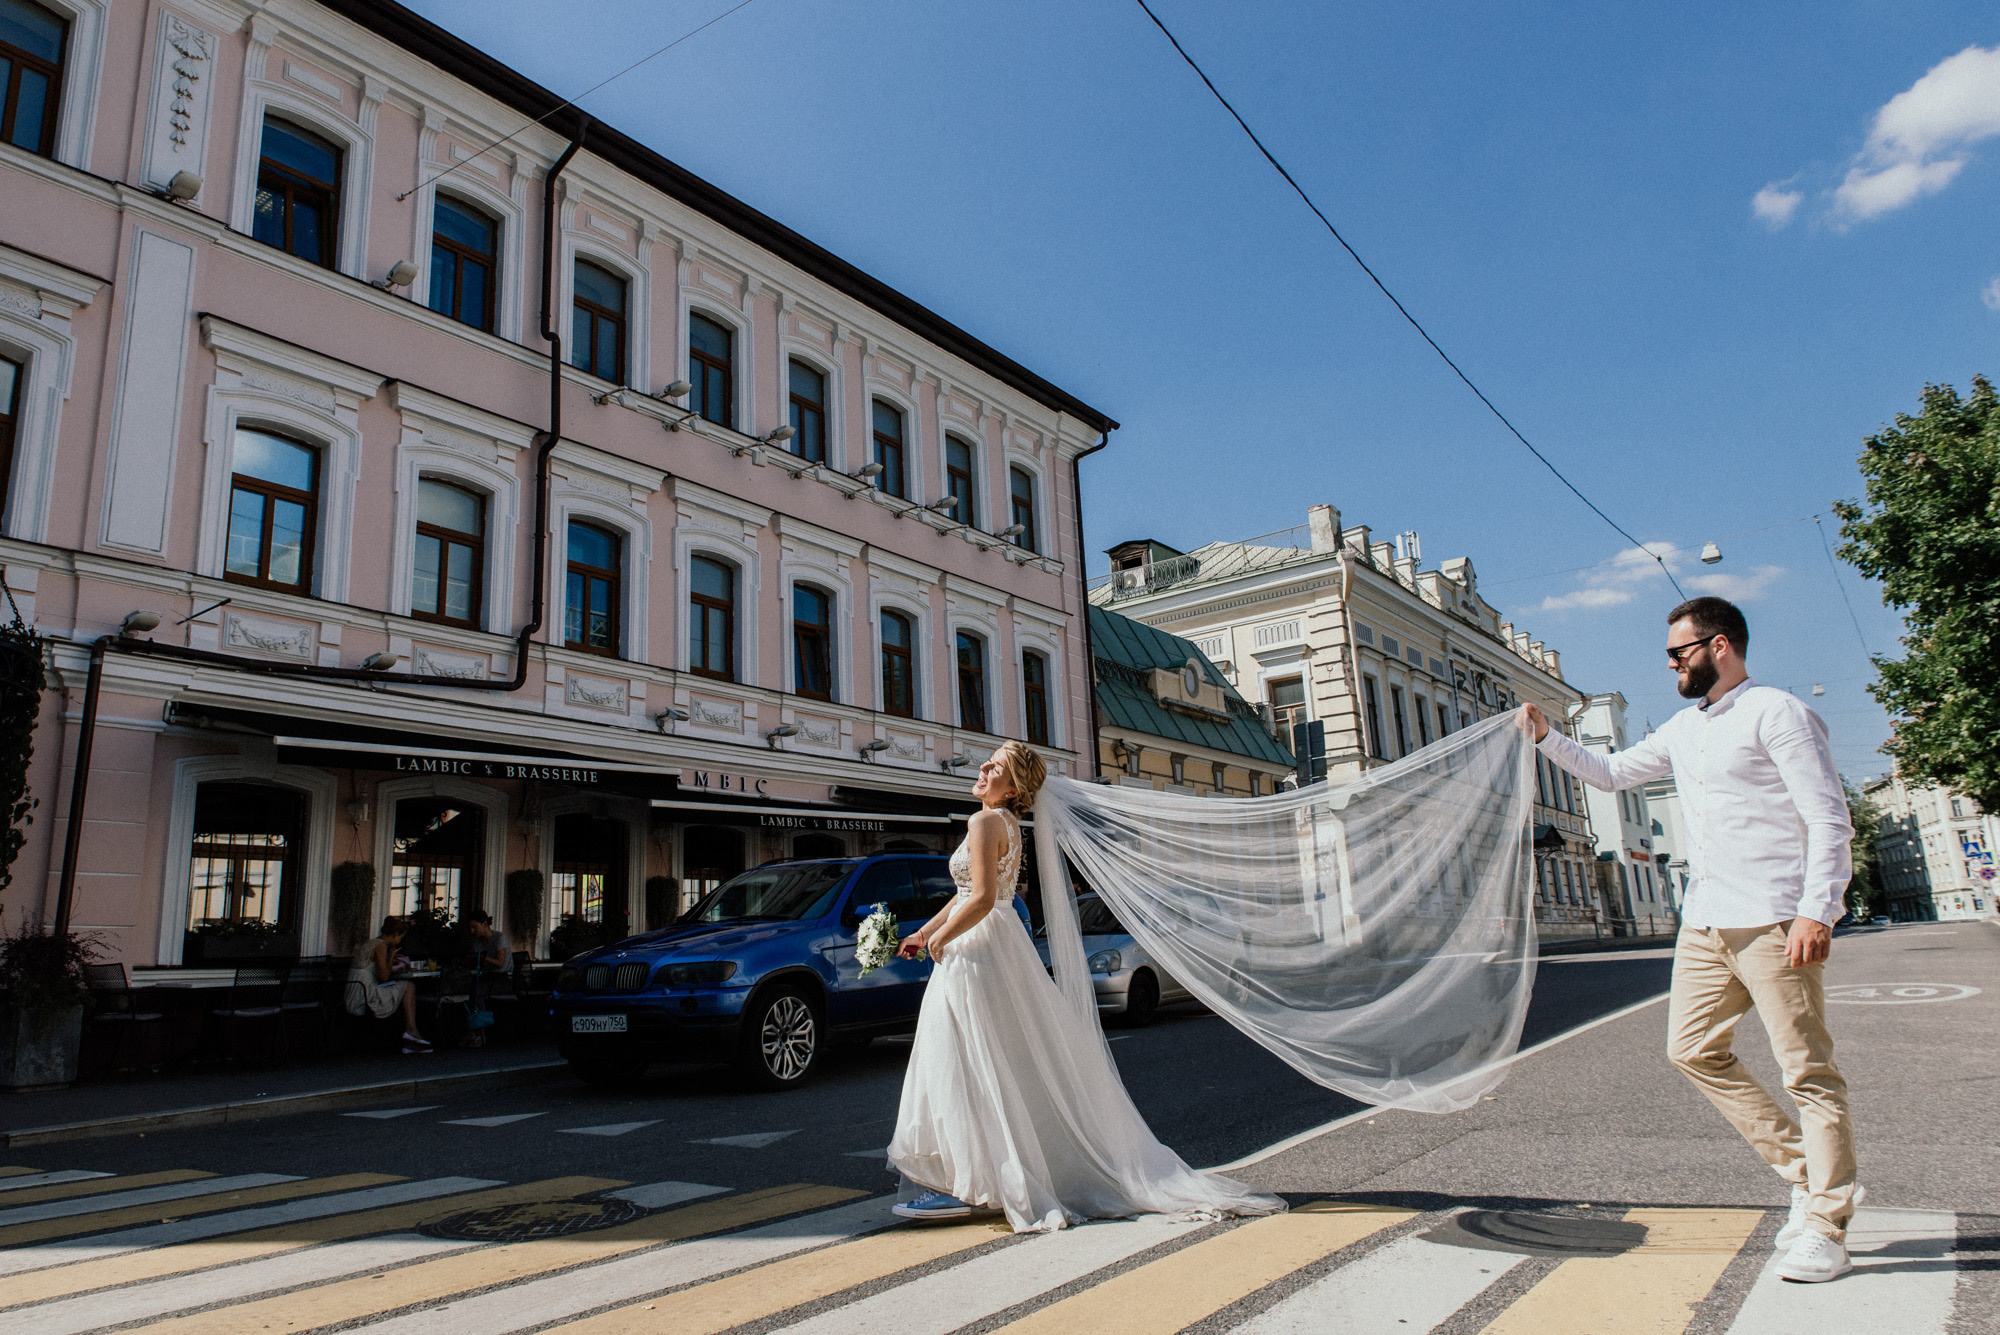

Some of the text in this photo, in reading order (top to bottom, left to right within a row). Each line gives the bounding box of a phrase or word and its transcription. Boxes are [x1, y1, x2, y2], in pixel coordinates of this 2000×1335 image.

[396, 757, 599, 783] LAMBIC BRASSERIE
[760, 815, 885, 831] LAMBIC BRASSERIE
[1827, 987, 1939, 998] 40
[609, 1016, 624, 1027] 750
